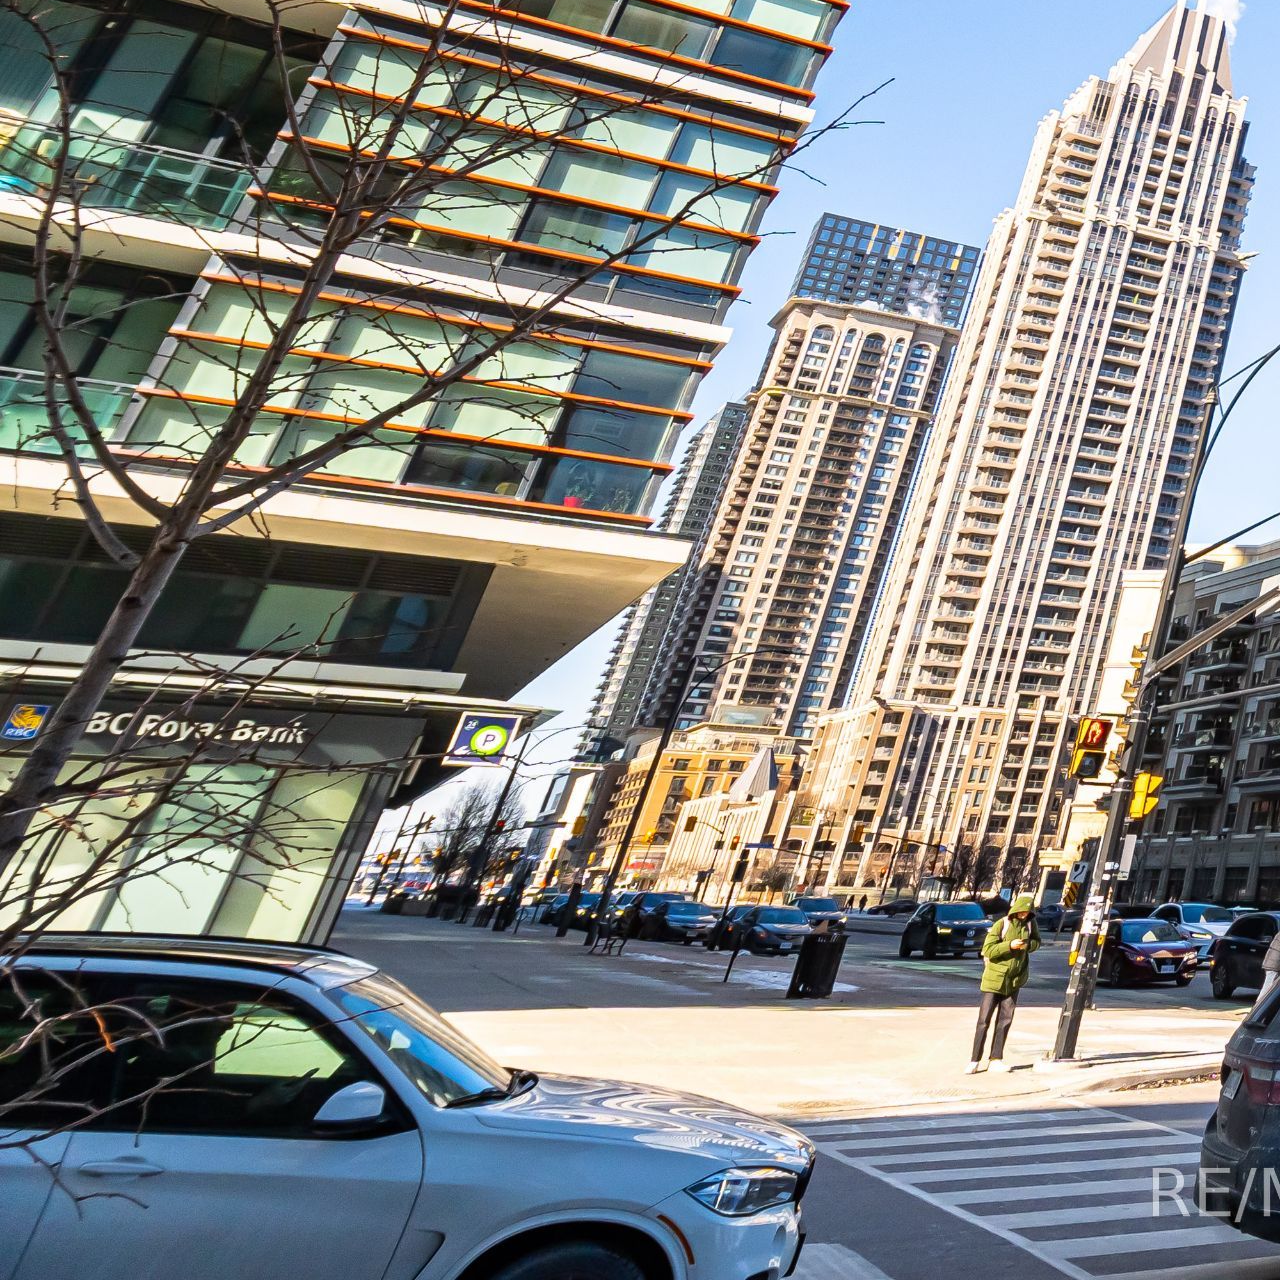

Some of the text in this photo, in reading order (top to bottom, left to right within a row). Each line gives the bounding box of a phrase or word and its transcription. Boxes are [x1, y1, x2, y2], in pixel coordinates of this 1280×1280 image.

[4, 728, 35, 737] RBC
[85, 711, 308, 744] BC Roya Bank
